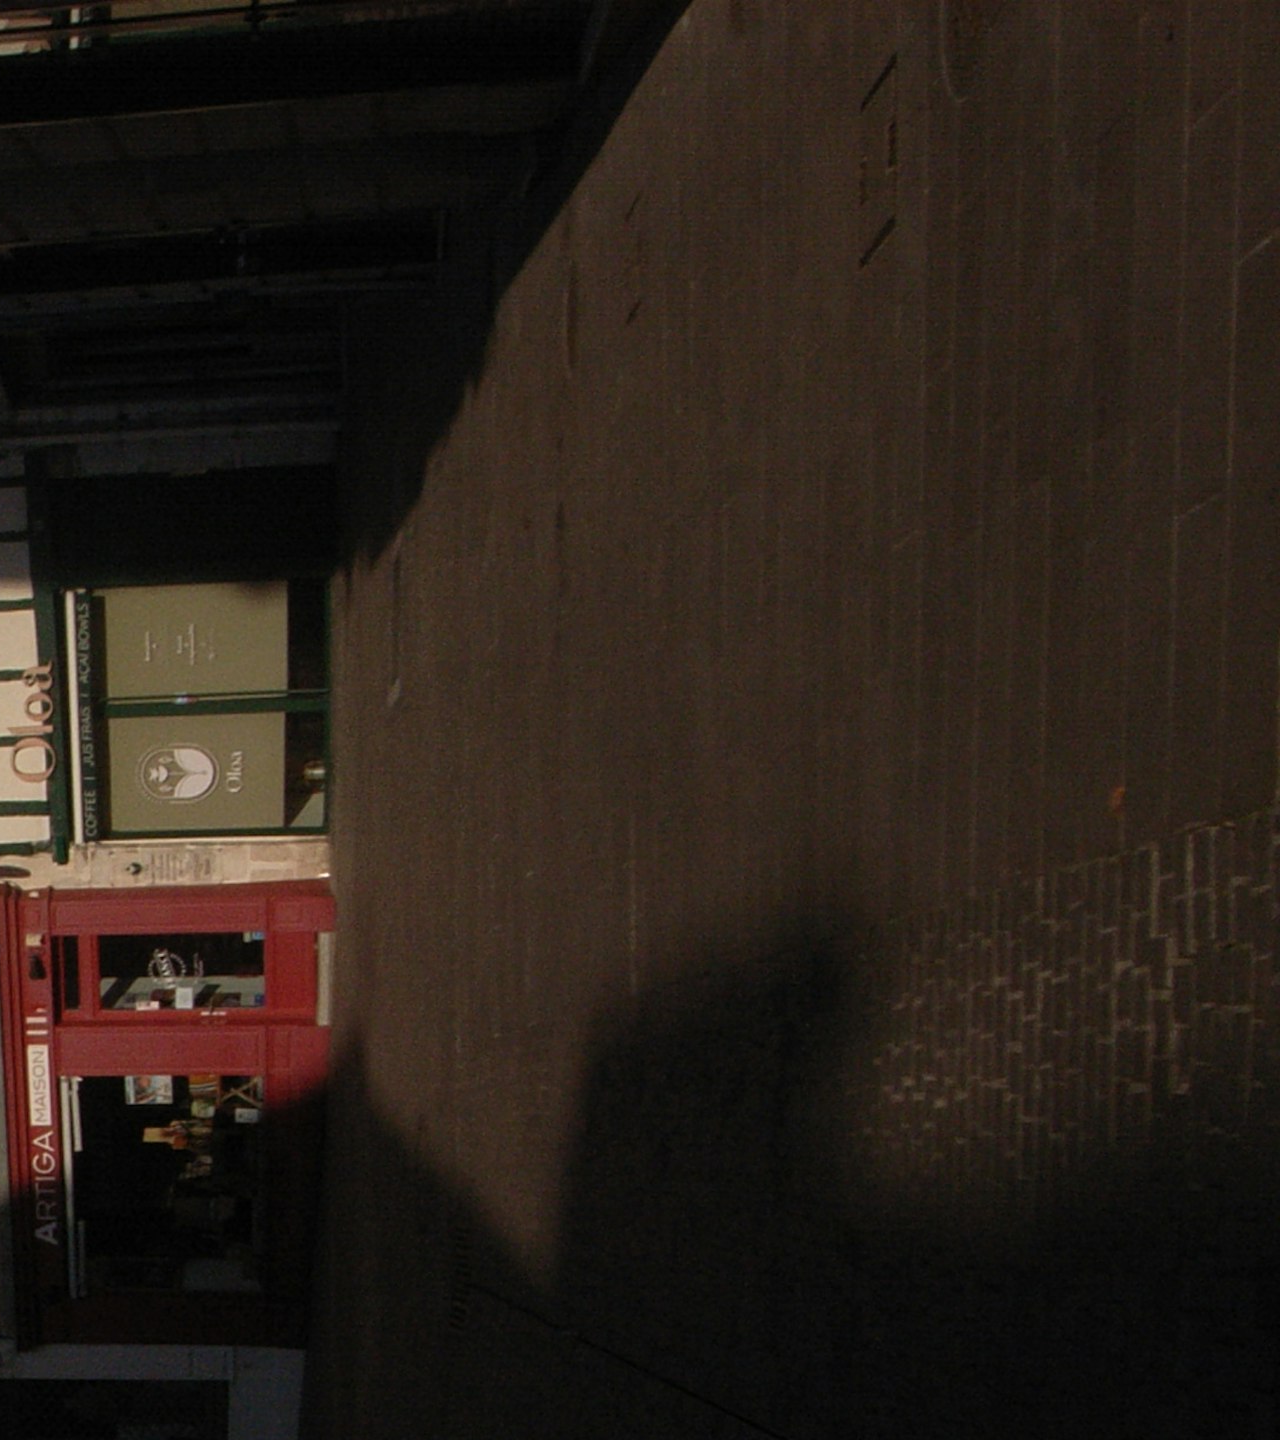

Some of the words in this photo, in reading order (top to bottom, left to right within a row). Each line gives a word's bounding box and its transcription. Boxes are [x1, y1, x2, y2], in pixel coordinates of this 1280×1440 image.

[76, 602, 90, 651] BOWLS
[8, 661, 56, 782] Oloa
[80, 706, 93, 741] FRAIS
[82, 743, 95, 767] JUS
[84, 789, 98, 837] COFFEE
[31, 1049, 47, 1123] MAISON
[33, 1131, 58, 1244] ARTIGA
